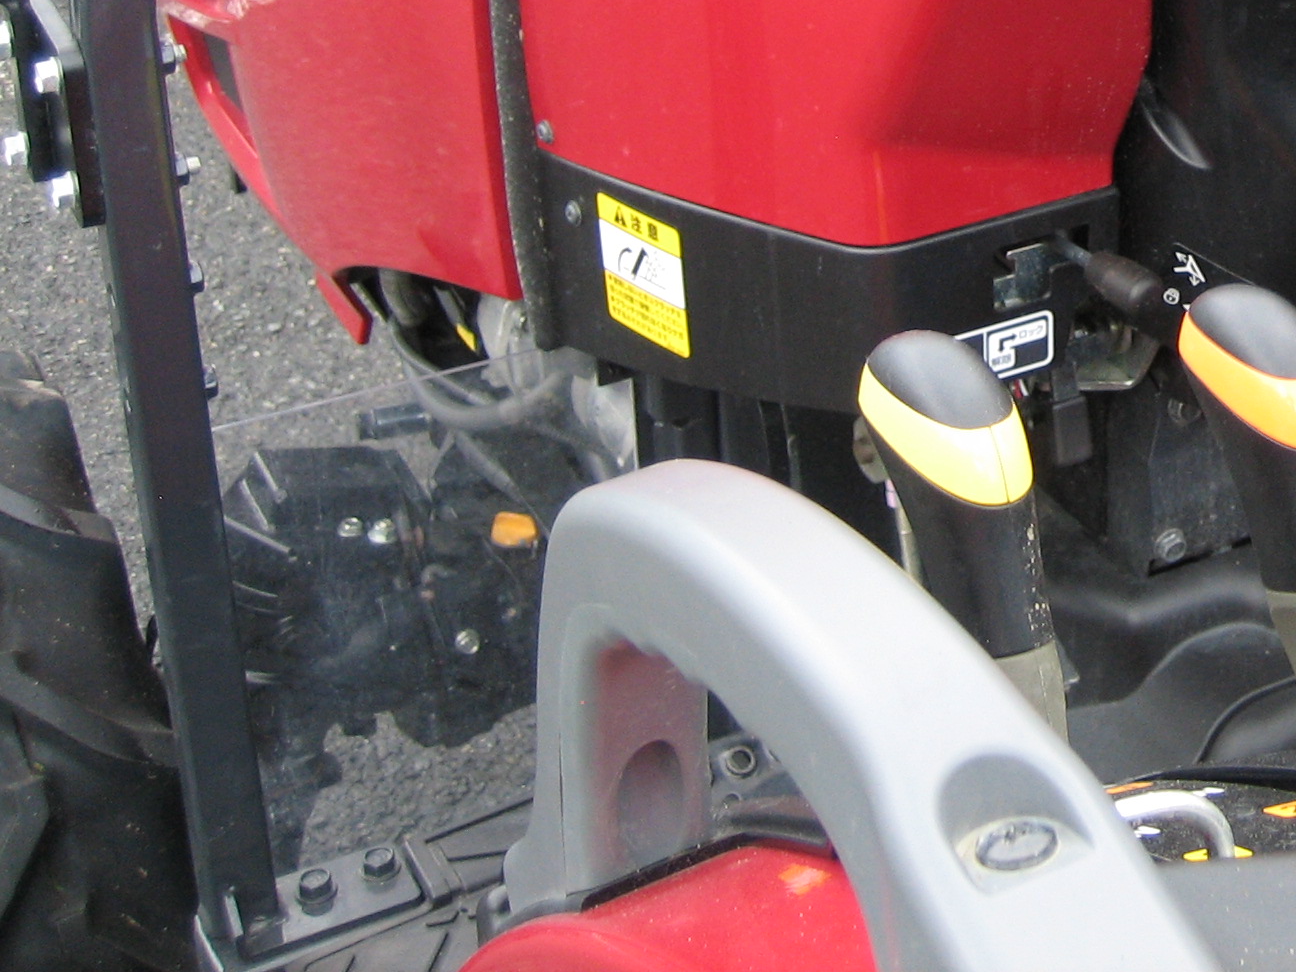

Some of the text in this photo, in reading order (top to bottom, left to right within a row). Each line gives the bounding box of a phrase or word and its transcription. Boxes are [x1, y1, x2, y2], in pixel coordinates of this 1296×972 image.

[630, 213, 659, 242] 注意
[1019, 324, 1044, 339] ロック
